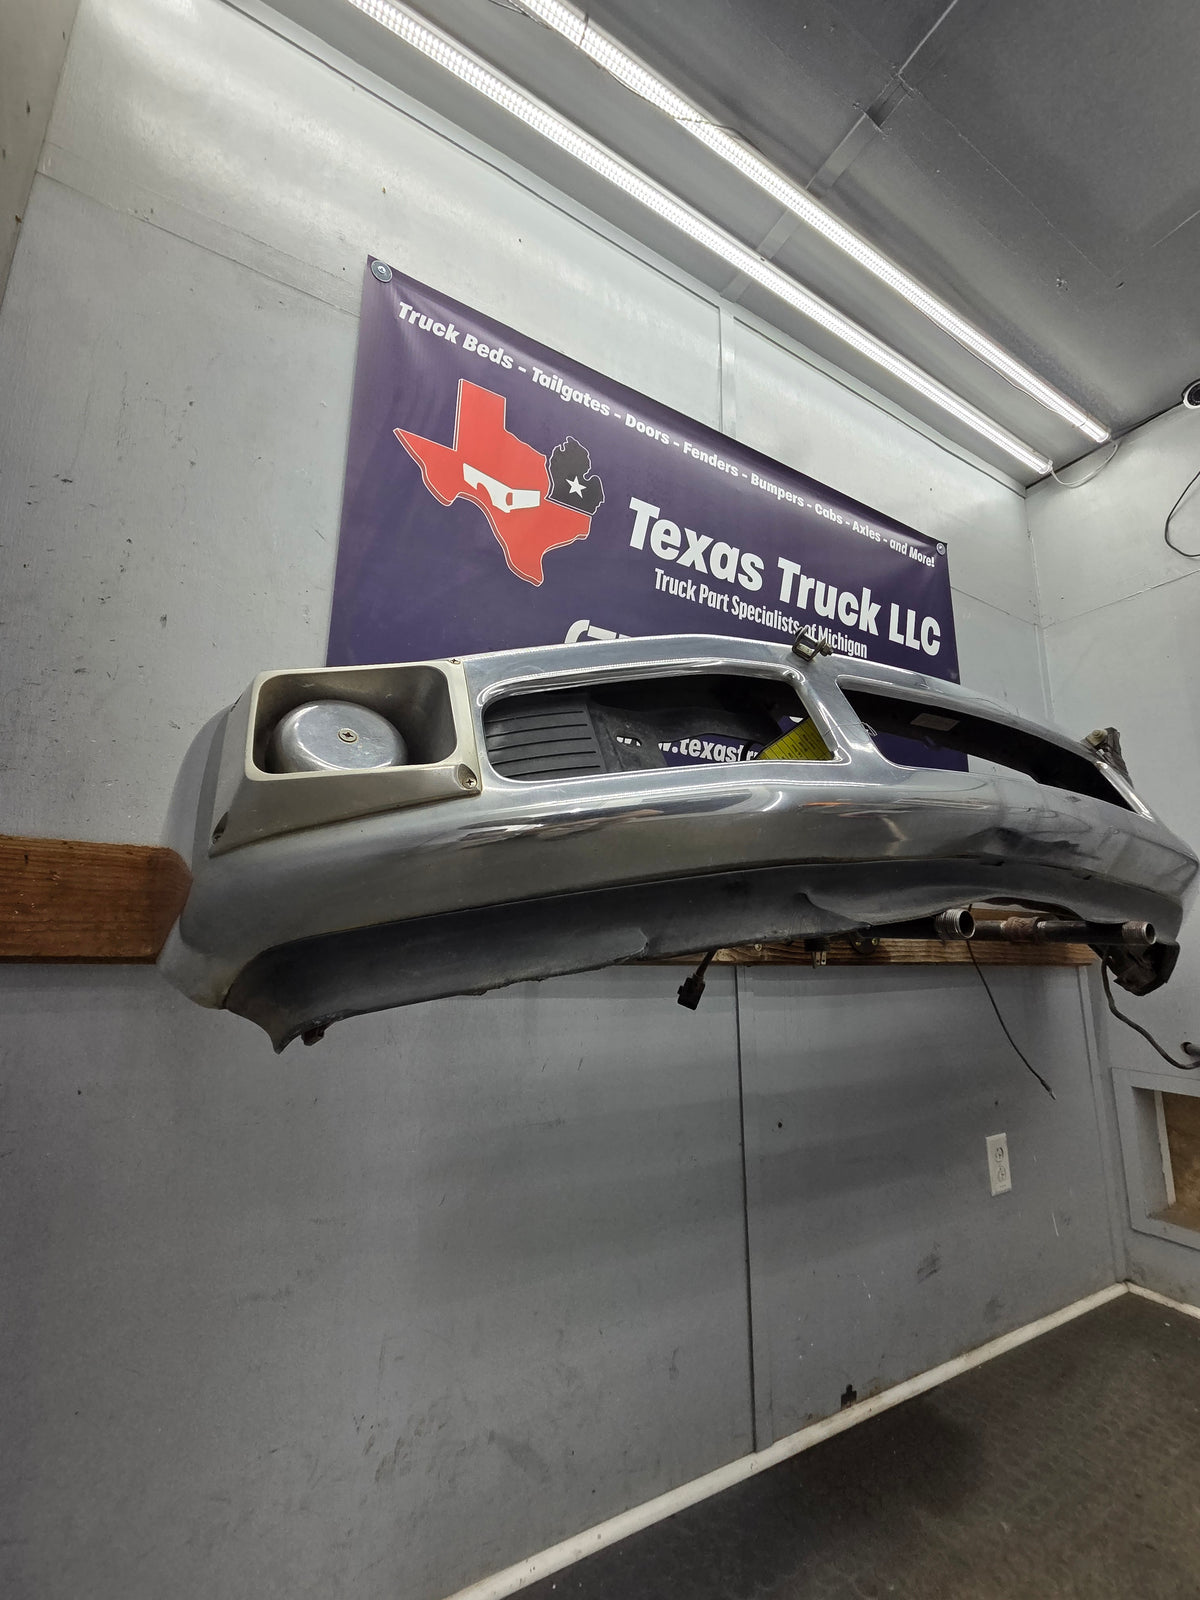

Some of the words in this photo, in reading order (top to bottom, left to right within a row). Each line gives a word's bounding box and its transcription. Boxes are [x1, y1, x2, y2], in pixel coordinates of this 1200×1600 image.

[398, 301, 460, 344] Truck
[462, 333, 514, 370] Beds
[532, 366, 611, 417] Tailgates
[624, 413, 670, 446] Doors
[683, 441, 739, 478] Fenders
[750, 472, 805, 508] Bumpers
[815, 503, 843, 526] Cabs
[852, 520, 881, 543] Axles
[889, 538, 908, 556] and
[909, 546, 935, 568] More!
[629, 496, 765, 591] Texas
[777, 556, 882, 636] Truck
[888, 602, 942, 657] LLC
[654, 567, 697, 602] Truck
[698, 583, 730, 613] Part
[730, 595, 800, 635] Specialists
[803, 623, 817, 640] of
[817, 625, 868, 659] Michigan
